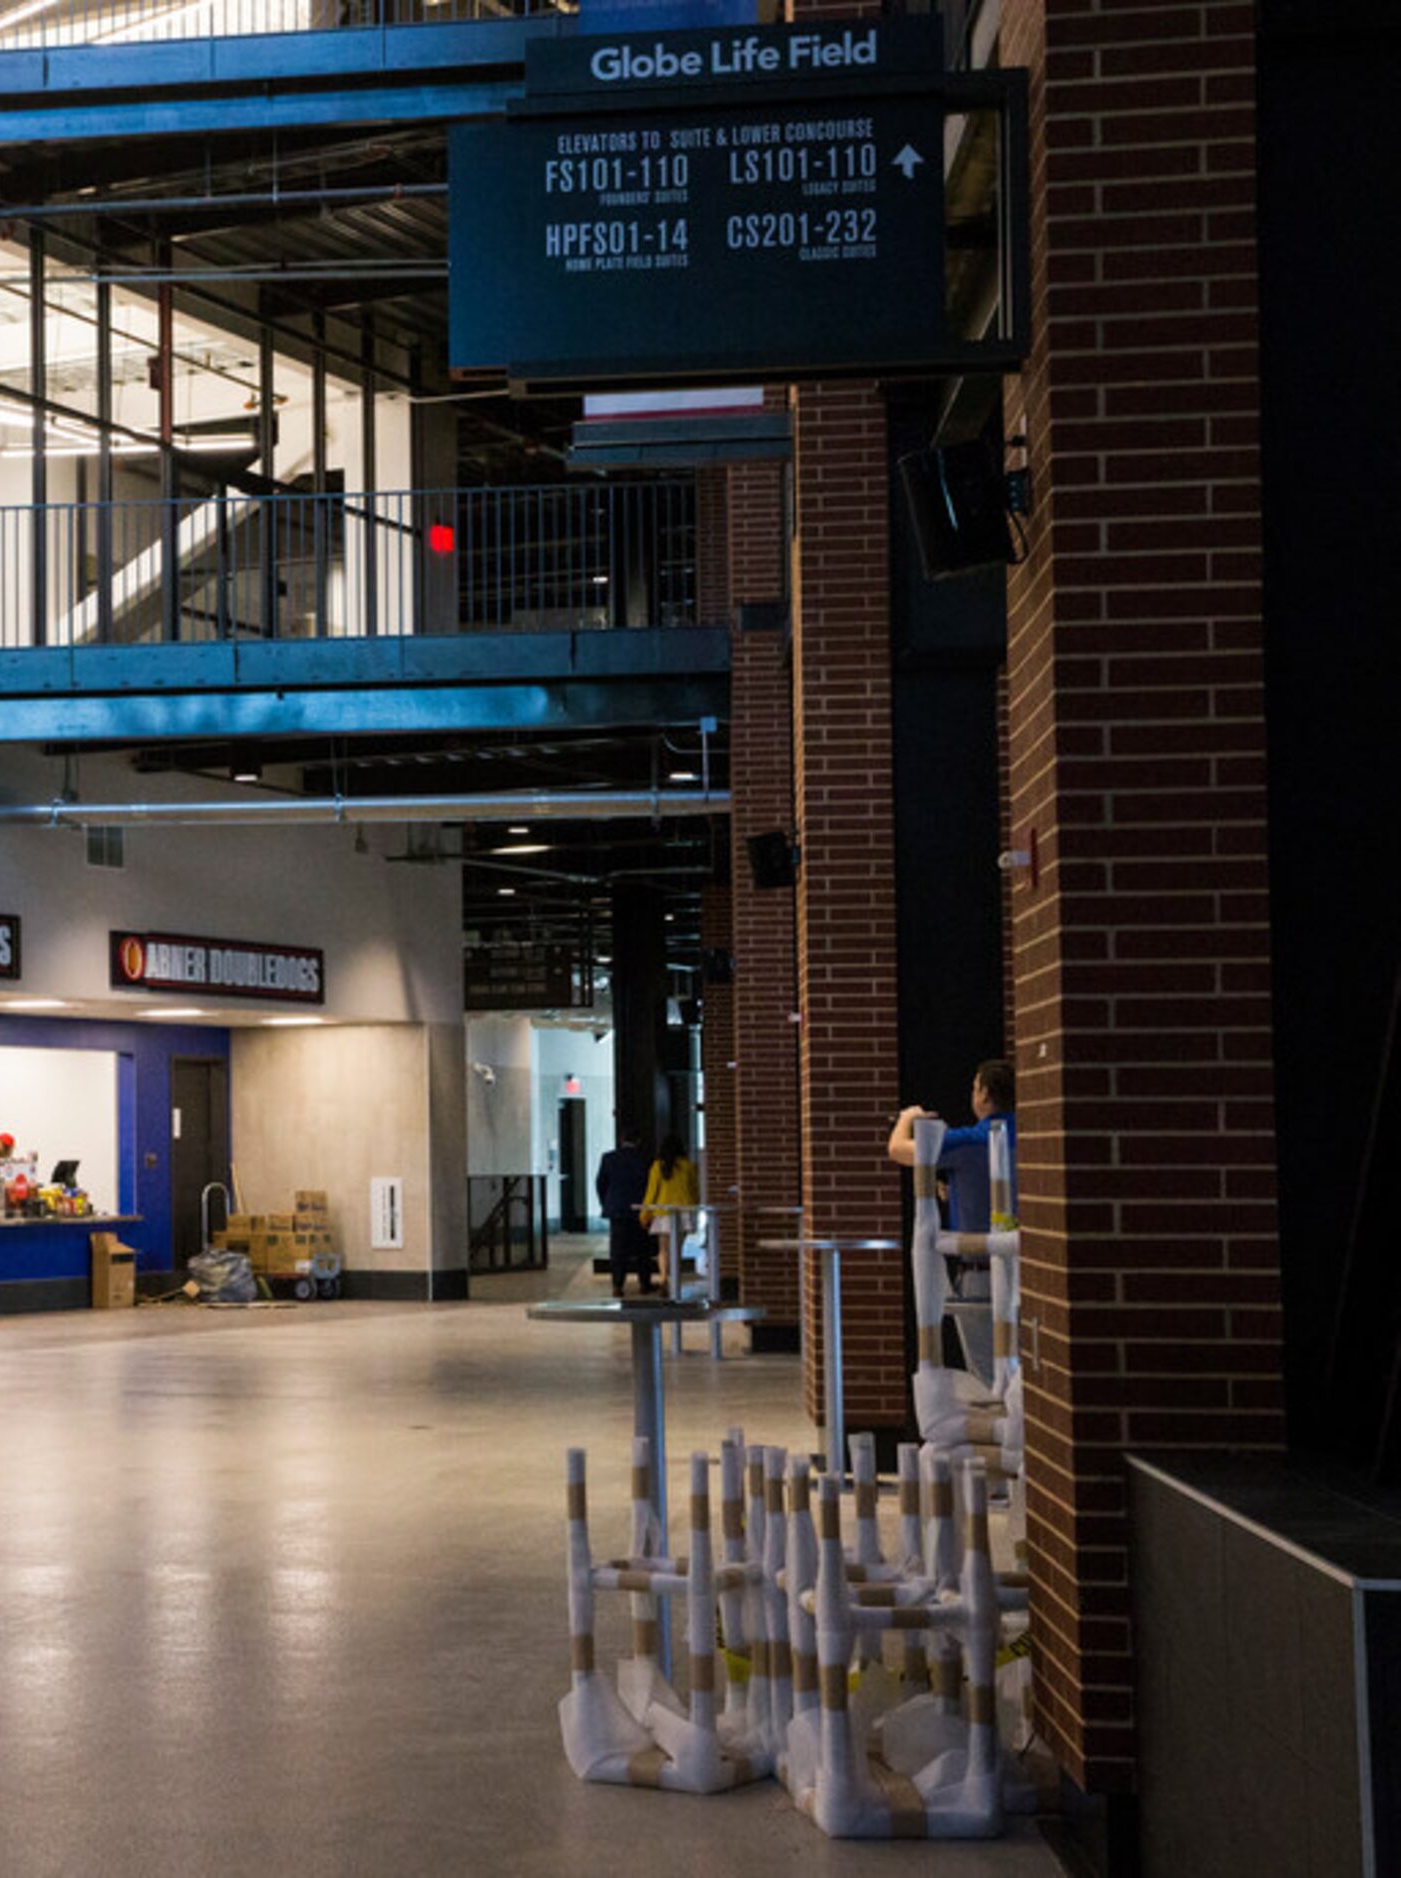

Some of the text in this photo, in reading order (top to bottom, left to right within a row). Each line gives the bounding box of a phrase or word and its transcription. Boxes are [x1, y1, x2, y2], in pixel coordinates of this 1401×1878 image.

[590, 29, 877, 81] Globe Life Field
[557, 117, 874, 155] ELEVATORS TO SUITE & LOWER CONCOURSE
[545, 154, 689, 193] FS101-110
[729, 143, 877, 185] LS101-110
[545, 218, 689, 257] HPFS01-14
[726, 208, 877, 249] CS201-232
[144, 942, 319, 992] ABNER DOUBLEDOGS
